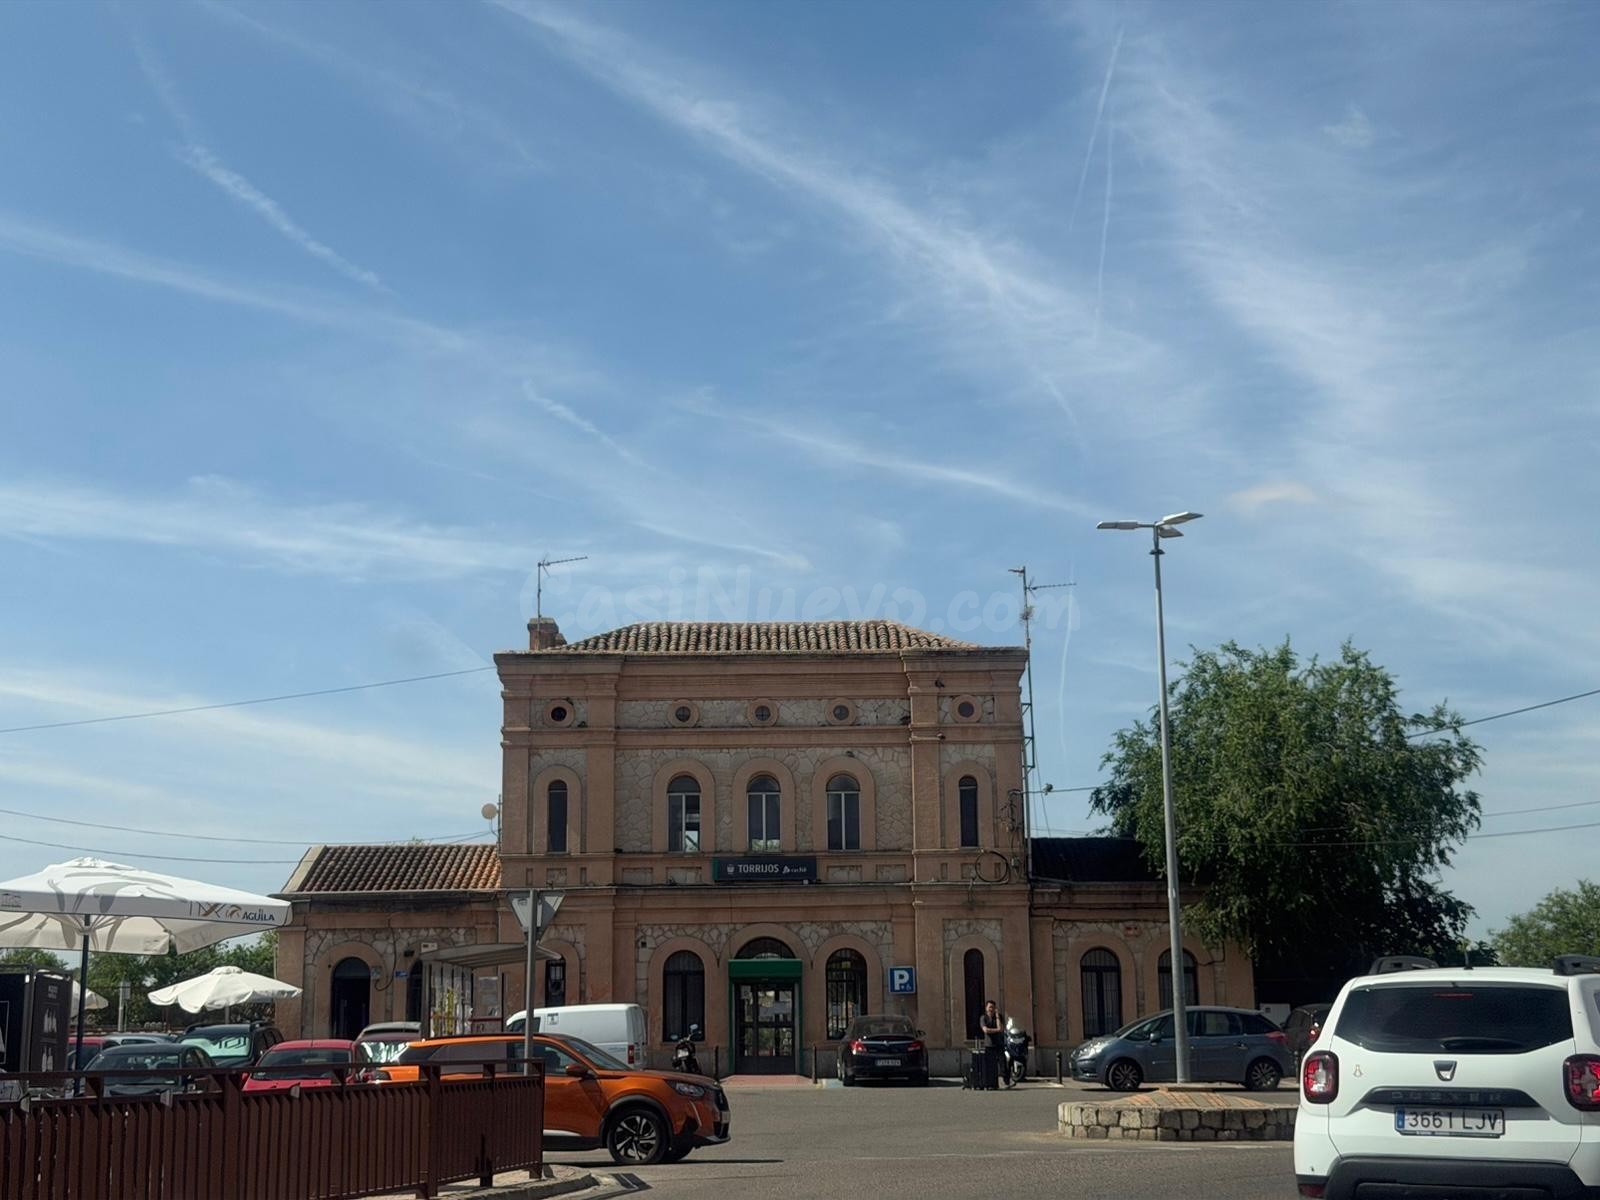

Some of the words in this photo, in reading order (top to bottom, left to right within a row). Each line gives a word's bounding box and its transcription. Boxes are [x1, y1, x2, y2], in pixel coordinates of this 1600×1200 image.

[737, 863, 780, 873] TORRIJOS
[894, 969, 910, 990] P
[1408, 1111, 1453, 1129] 3661
[1462, 1112, 1499, 1130] LJV
